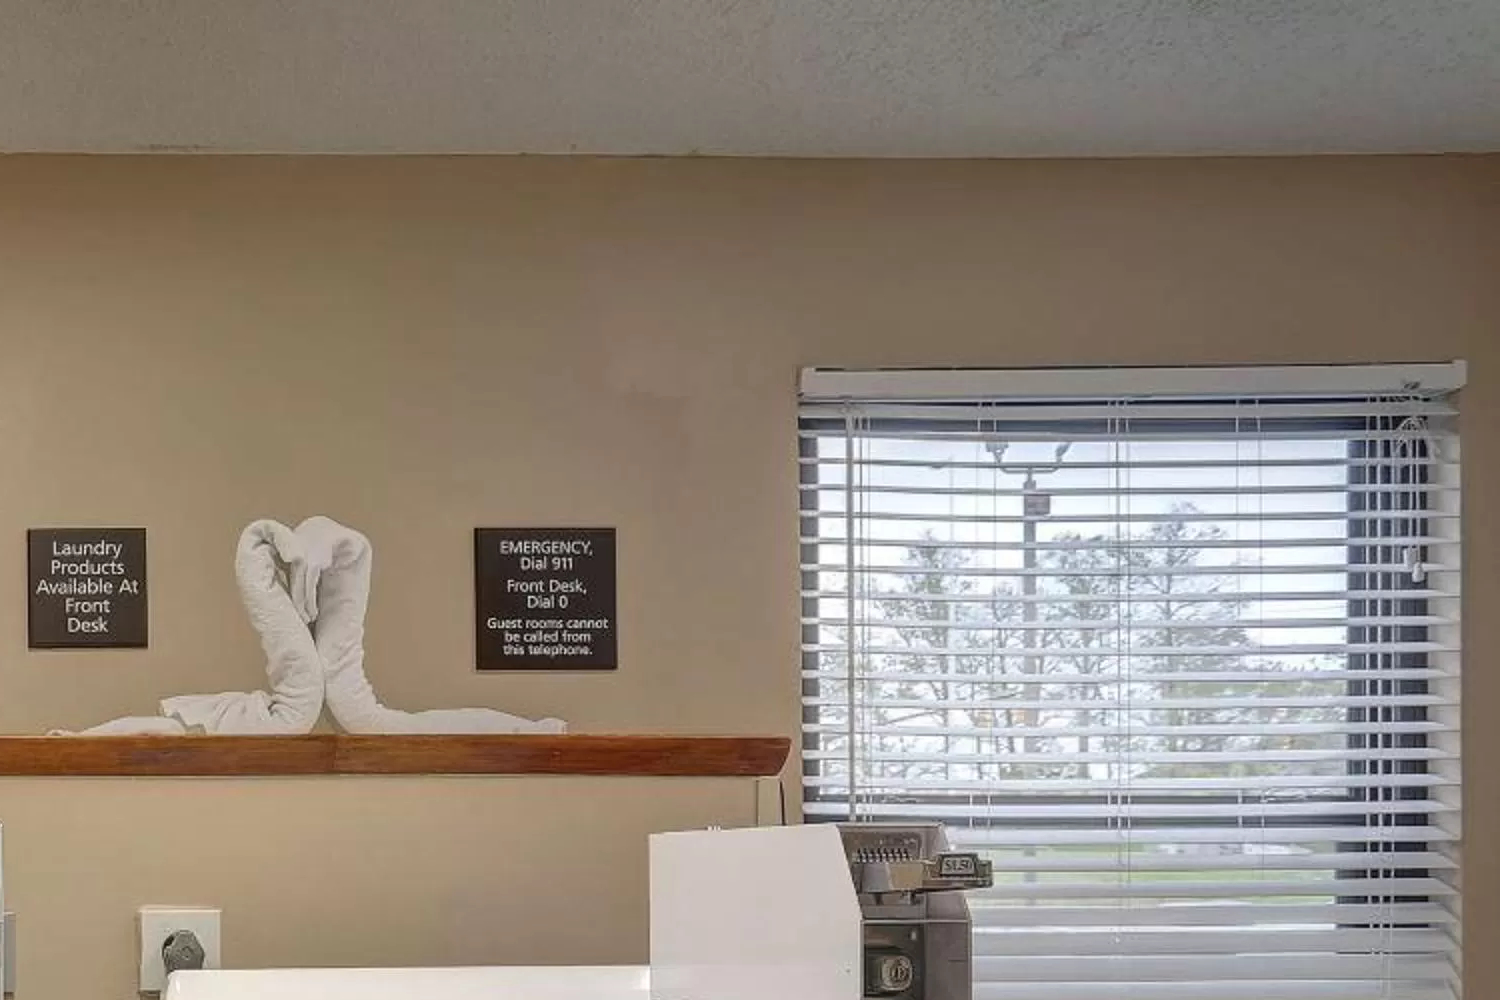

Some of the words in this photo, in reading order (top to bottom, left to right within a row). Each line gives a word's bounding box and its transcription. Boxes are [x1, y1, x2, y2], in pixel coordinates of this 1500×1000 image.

[52, 540, 123, 559] Laundry
[499, 540, 593, 556] EMERGENCY,
[51, 559, 125, 575] Products
[520, 556, 547, 570] Dial
[551, 557, 573, 570] 911
[35, 577, 113, 595] Available
[118, 579, 139, 595] At
[506, 579, 545, 593] Front
[549, 578, 587, 594] Desk,
[65, 597, 111, 613] Front
[527, 595, 555, 609] Dial
[559, 595, 569, 609] 0
[67, 616, 108, 633] Desk
[486, 617, 523, 629] Guest
[525, 619, 563, 629] rooms
[566, 618, 609, 629] cannot
[504, 630, 520, 642] be
[523, 630, 559, 643] called
[561, 630, 591, 642] from
[503, 643, 525, 656] this
[528, 643, 593, 658] telephone.
